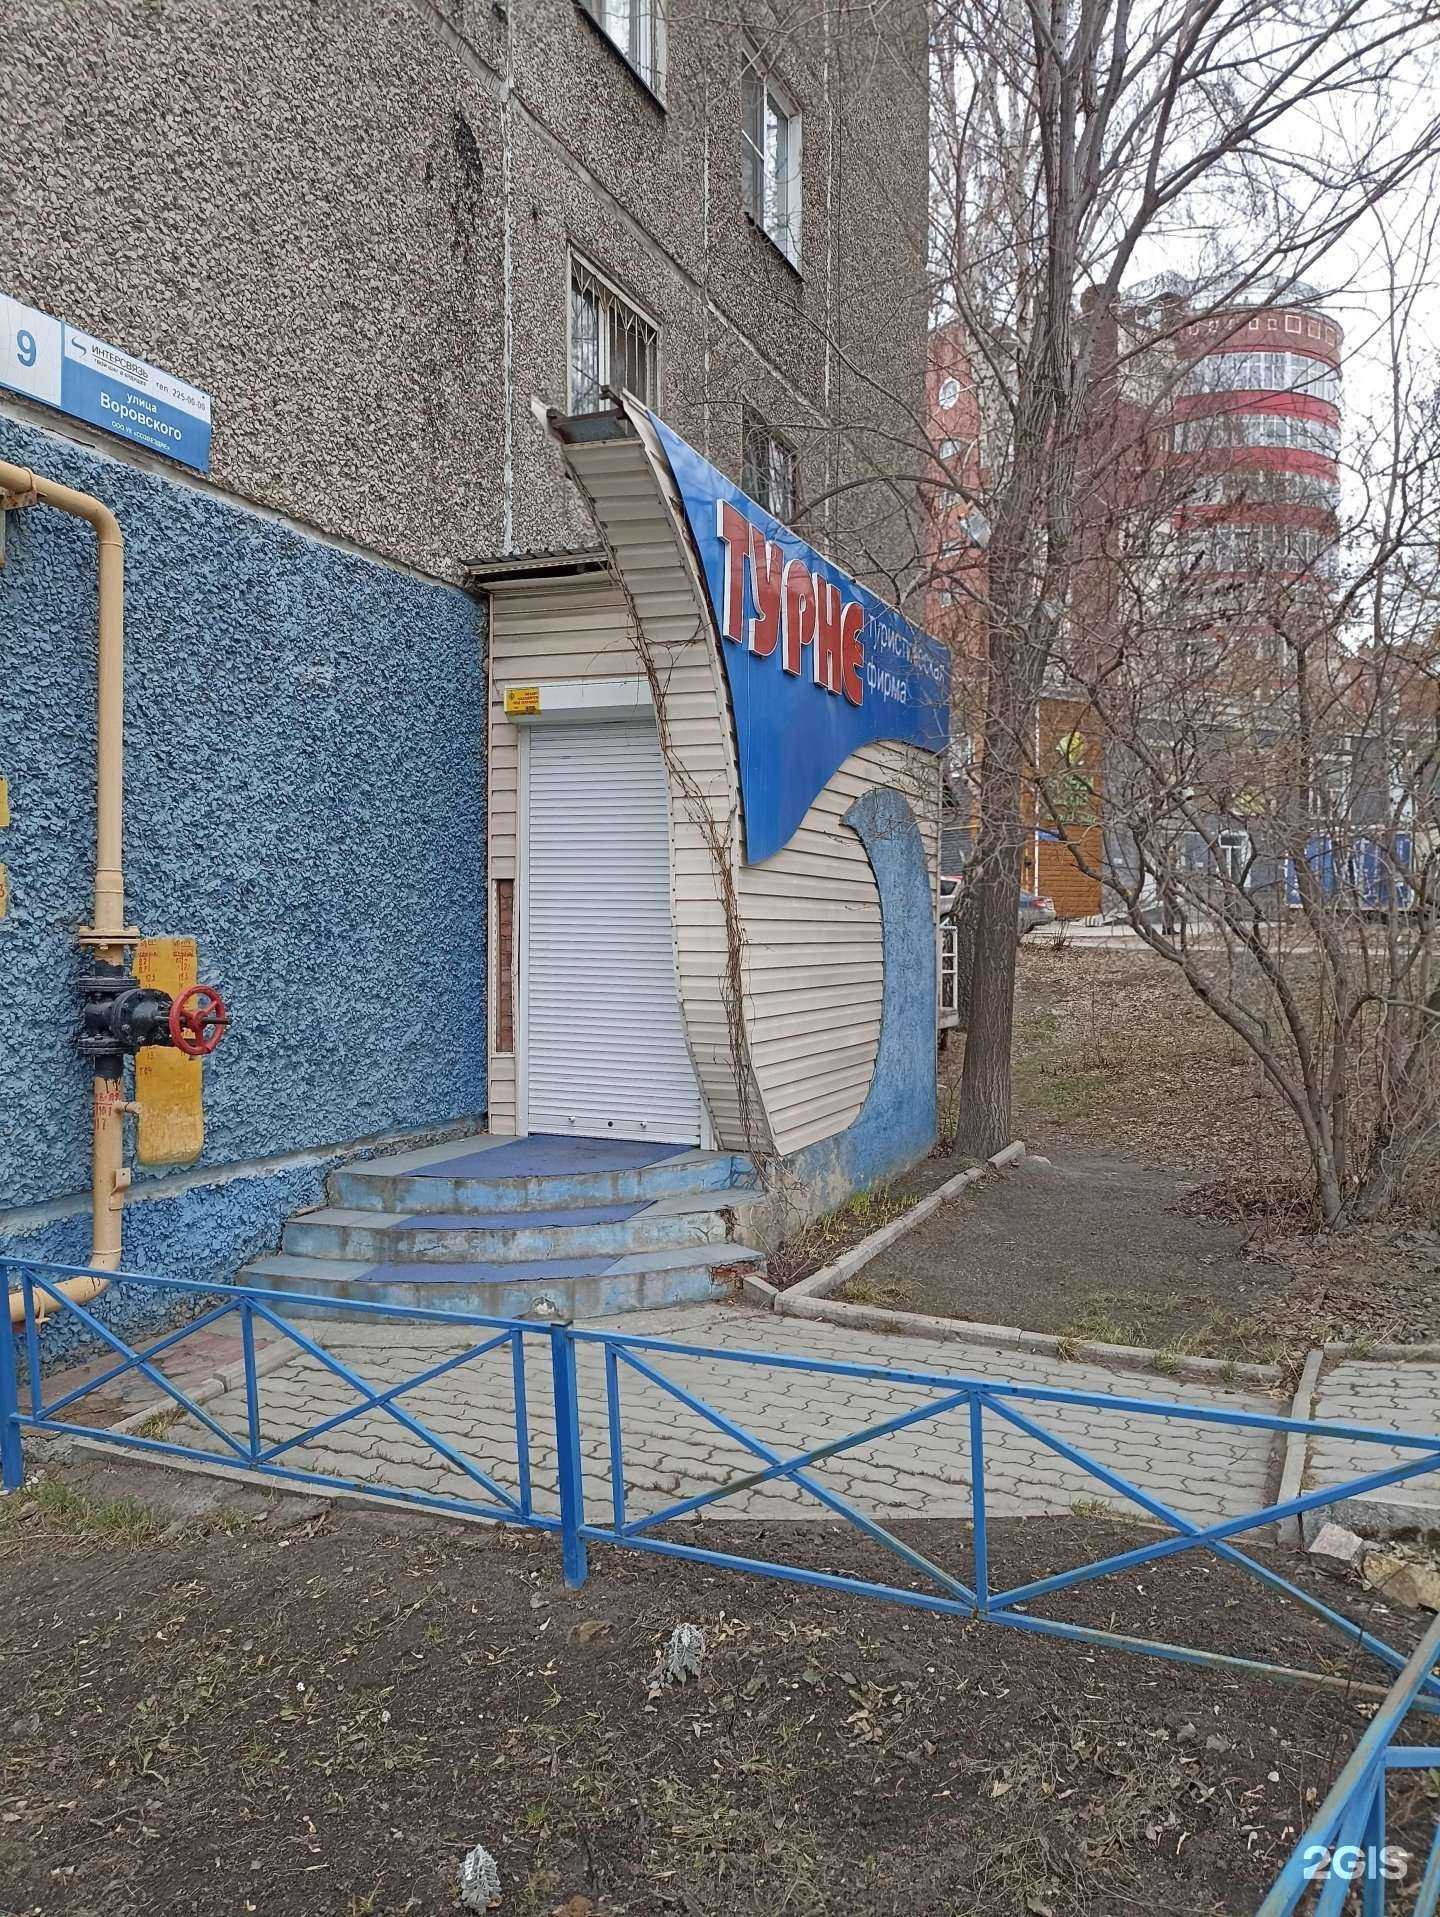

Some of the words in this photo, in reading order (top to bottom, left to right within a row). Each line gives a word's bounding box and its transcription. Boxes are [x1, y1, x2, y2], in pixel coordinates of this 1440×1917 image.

[17, 330, 36, 367] 9
[91, 345, 149, 378] ИНТЕРСВЯЗЬ
[100, 391, 182, 441] Воровского
[127, 393, 157, 414] улица
[717, 498, 865, 706] ТУРНЕ
[866, 655, 907, 705] фирма
